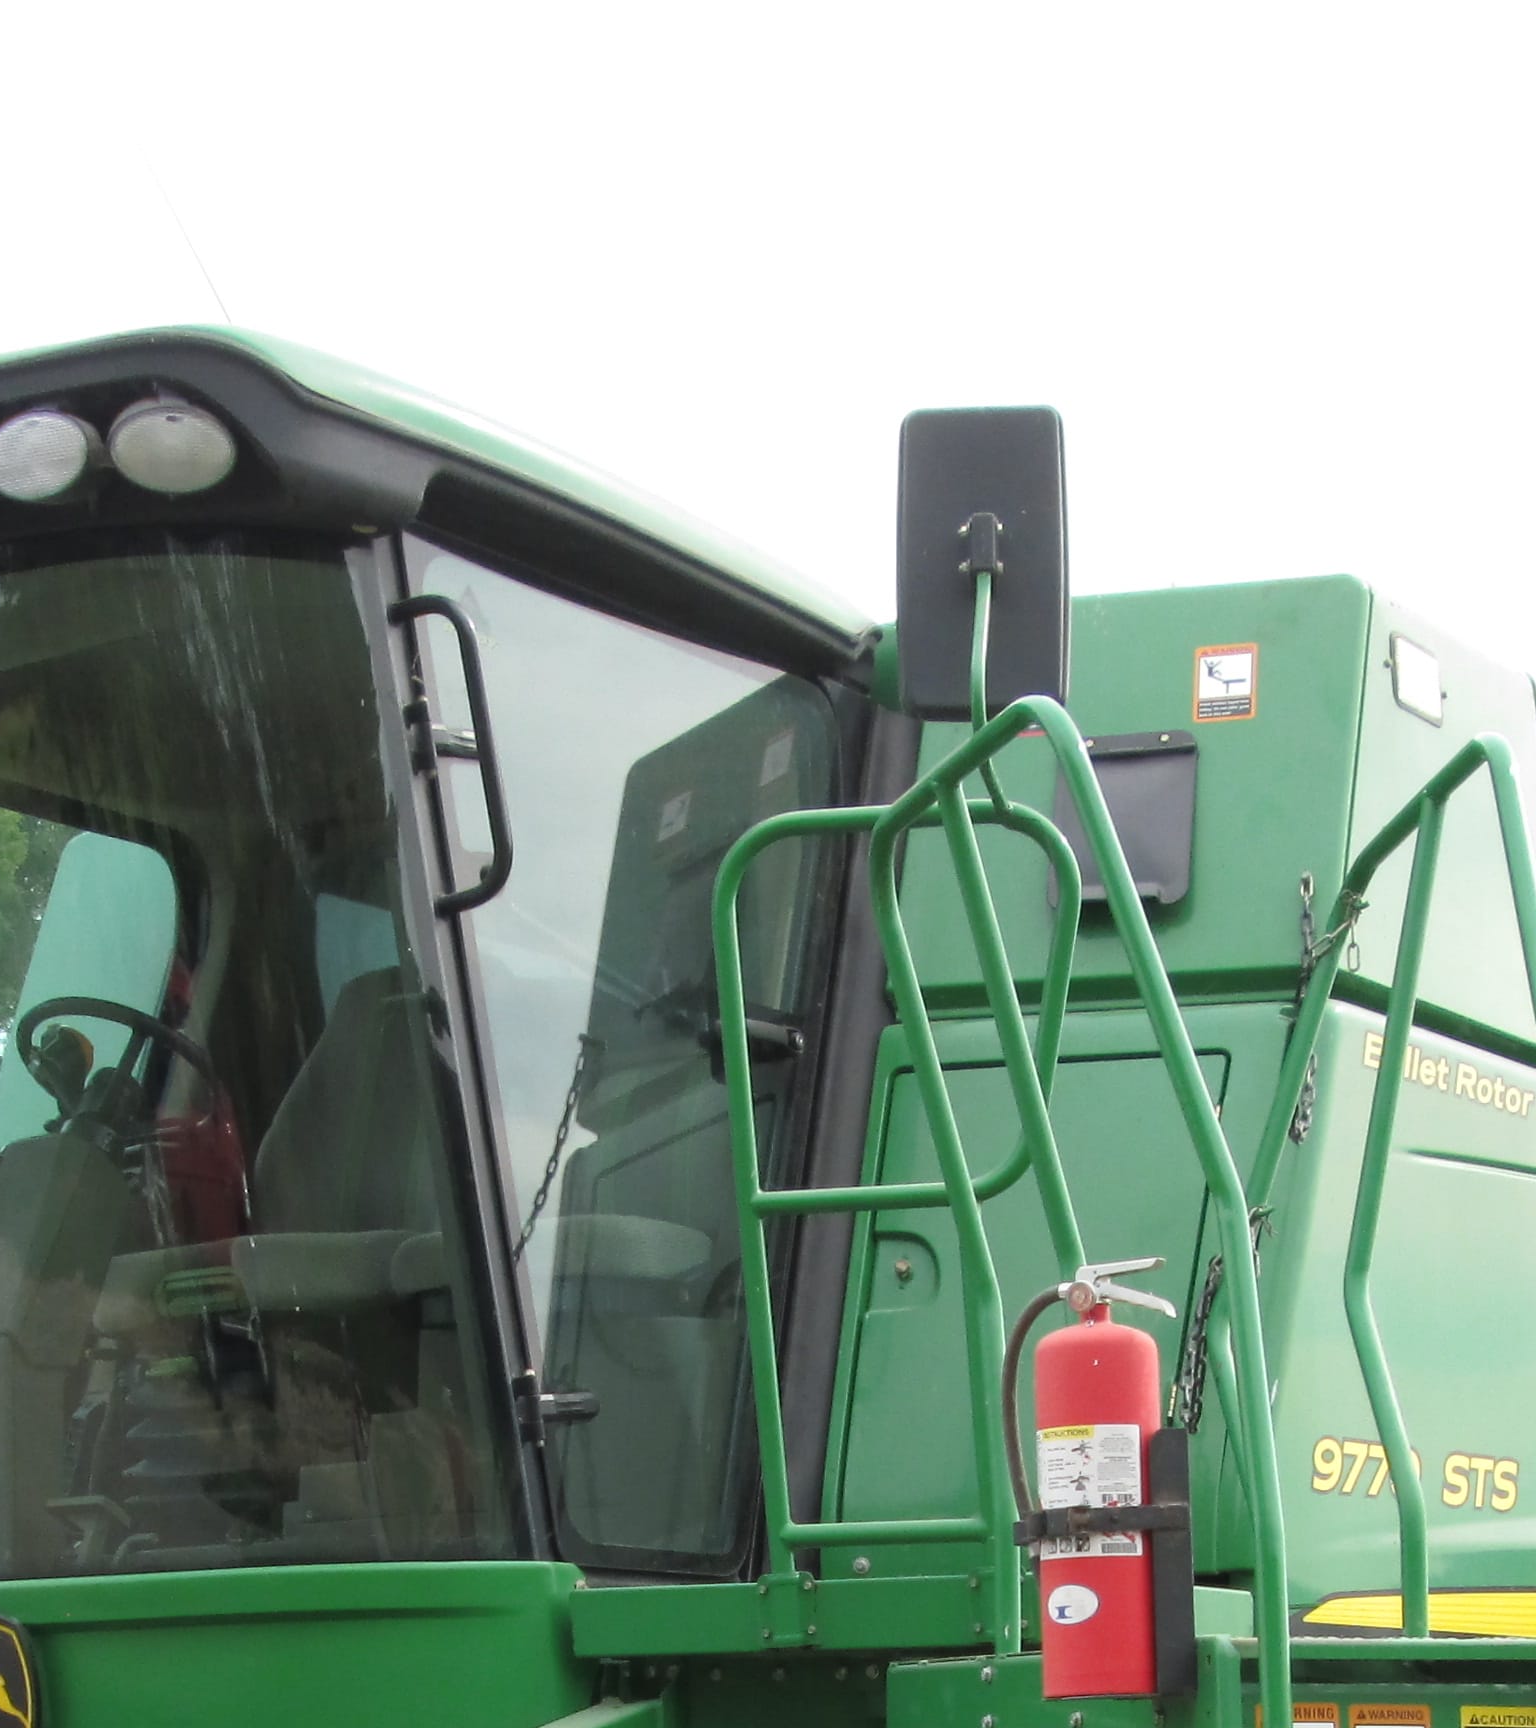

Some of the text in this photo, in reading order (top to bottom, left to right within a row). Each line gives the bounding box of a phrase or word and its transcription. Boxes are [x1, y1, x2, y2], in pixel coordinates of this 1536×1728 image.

[1455, 1062, 1535, 1117] Rotor
[1440, 1451, 1520, 1513] STS
[1294, 1707, 1335, 1720] RNING
[1368, 1710, 1424, 1721] WARNING
[1480, 1714, 1535, 1726] CAUTION
